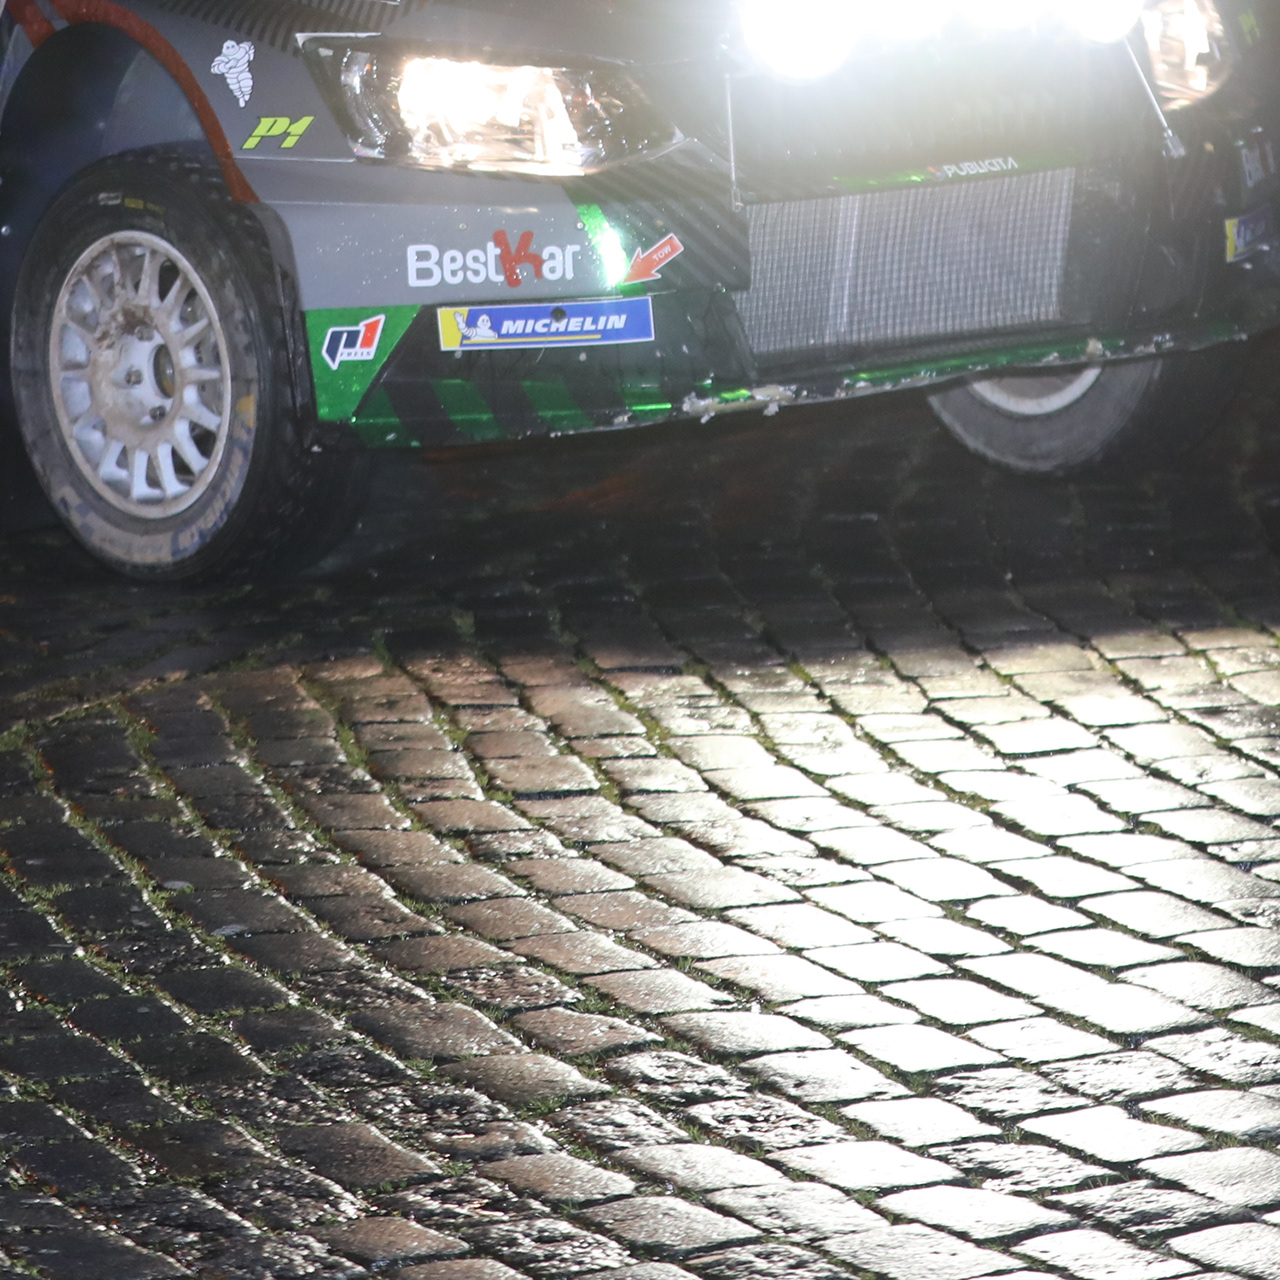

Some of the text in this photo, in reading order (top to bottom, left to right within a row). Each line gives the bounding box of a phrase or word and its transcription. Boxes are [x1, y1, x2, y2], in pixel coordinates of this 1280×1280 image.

[241, 116, 315, 150] P1
[406, 229, 581, 288] BestKar
[652, 244, 672, 262] TOW
[500, 314, 627, 335] MICHELIN
